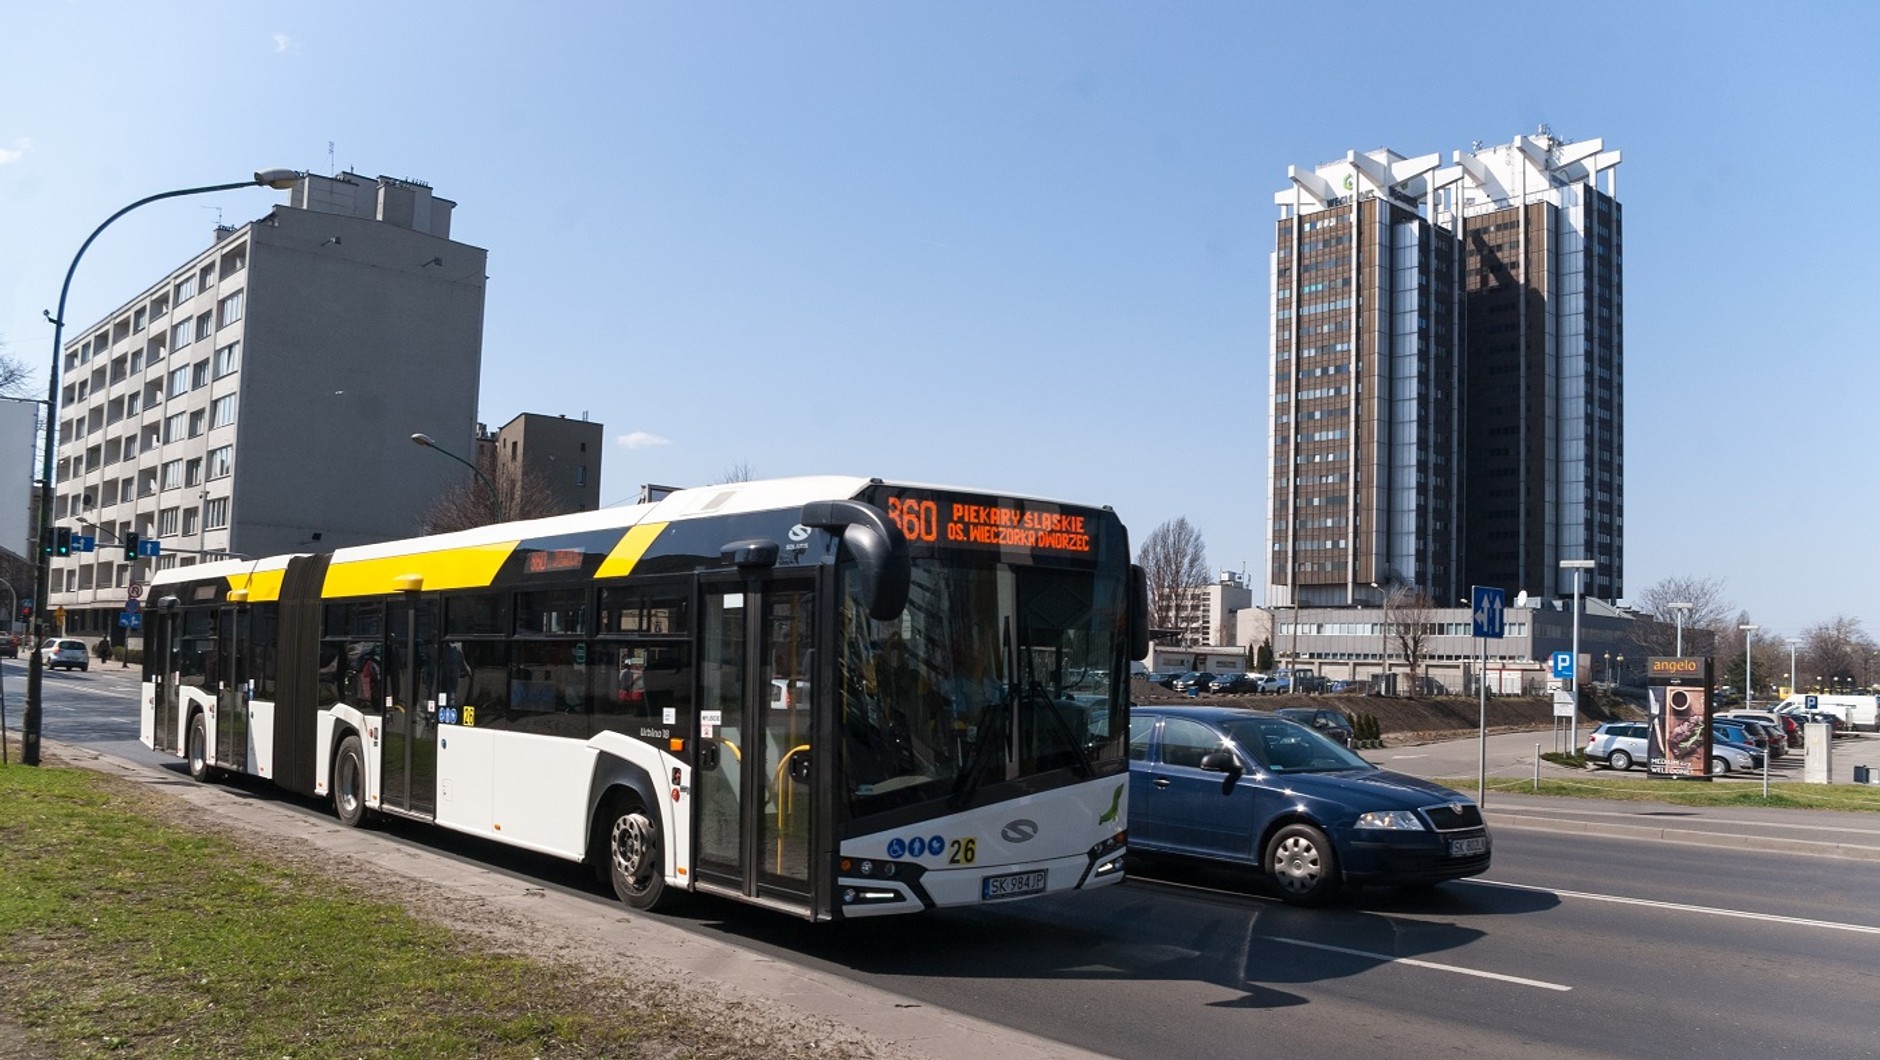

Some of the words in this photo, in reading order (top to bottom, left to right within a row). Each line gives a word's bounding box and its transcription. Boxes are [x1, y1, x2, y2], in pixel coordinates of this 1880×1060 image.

[953, 503, 1020, 527] PIEKARY
[947, 522, 967, 541] OS.
[969, 524, 1036, 546] WIECZORKA
[1038, 531, 1090, 551] DWORZEC
[1557, 654, 1570, 670] P
[1653, 660, 1696, 674] angelo
[1807, 697, 1815, 709] P
[464, 707, 473, 725] 26
[640, 727, 662, 738] Urbino
[663, 728, 670, 739] 18
[949, 838, 976, 864] 26
[991, 878, 1007, 894] SK
[1010, 873, 1044, 891] 984JP
